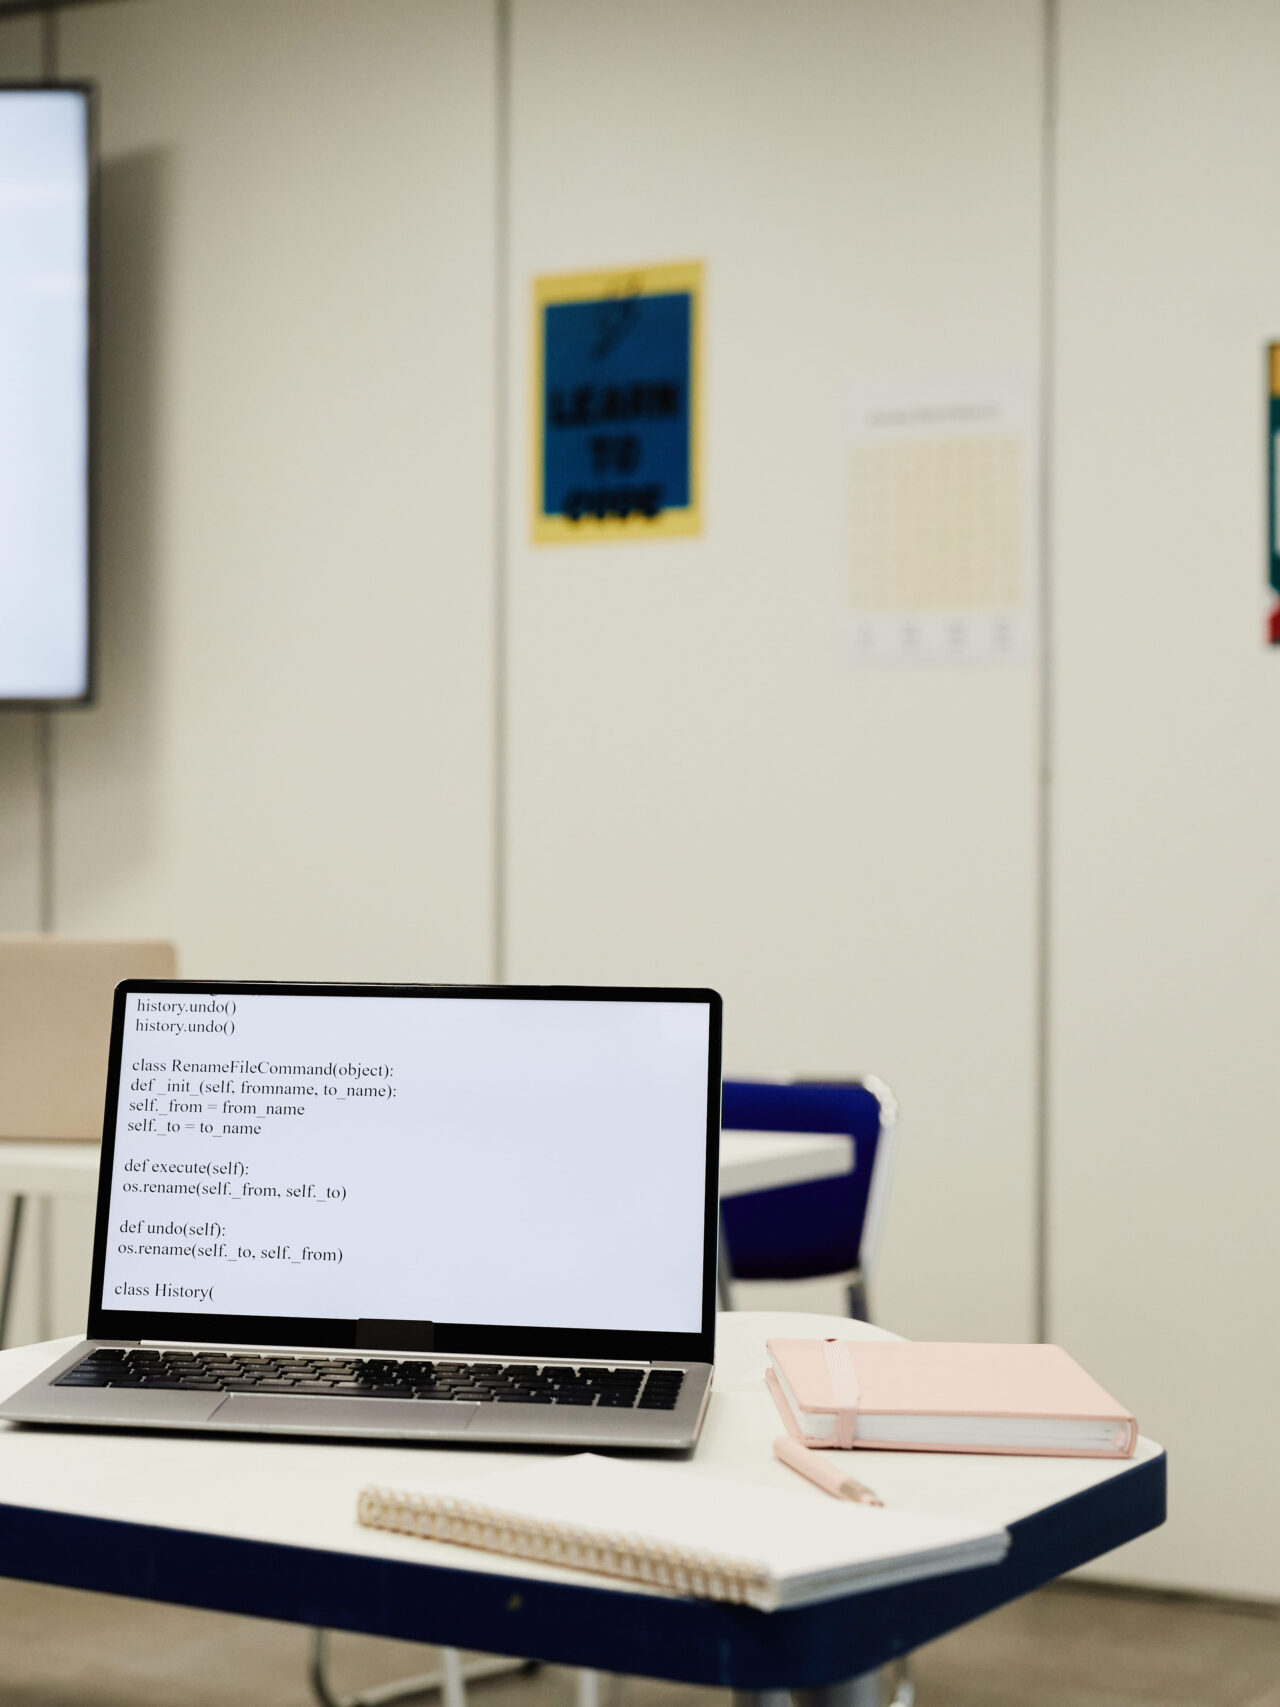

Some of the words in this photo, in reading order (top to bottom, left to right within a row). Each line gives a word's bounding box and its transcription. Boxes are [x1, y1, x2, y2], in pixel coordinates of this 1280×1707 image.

[550, 384, 678, 427] LEARN
[589, 434, 641, 475] TO
[137, 998, 237, 1016] history.undo()
[135, 1017, 236, 1036] history.undo()
[131, 1058, 167, 1072] class
[171, 1058, 394, 1080] RenameFileCommand(object):
[130, 1077, 157, 1092] def
[323, 1084, 397, 1101] to_name):
[128, 1098, 203, 1116] self._from
[222, 1100, 306, 1119] from_name
[127, 1118, 181, 1137] self._to
[199, 1121, 262, 1138] to_name
[124, 1158, 151, 1173] def
[151, 1161, 249, 1178] execute(self):
[122, 1181, 281, 1200] os.rename(self._from,
[285, 1183, 347, 1203] self._to)
[119, 1219, 145, 1234] def
[147, 1220, 226, 1240] undo(self):
[117, 1242, 256, 1262] os.rename(self._to,
[260, 1245, 343, 1265] self._from)
[114, 1281, 150, 1297] class
[154, 1282, 214, 1303] History(
